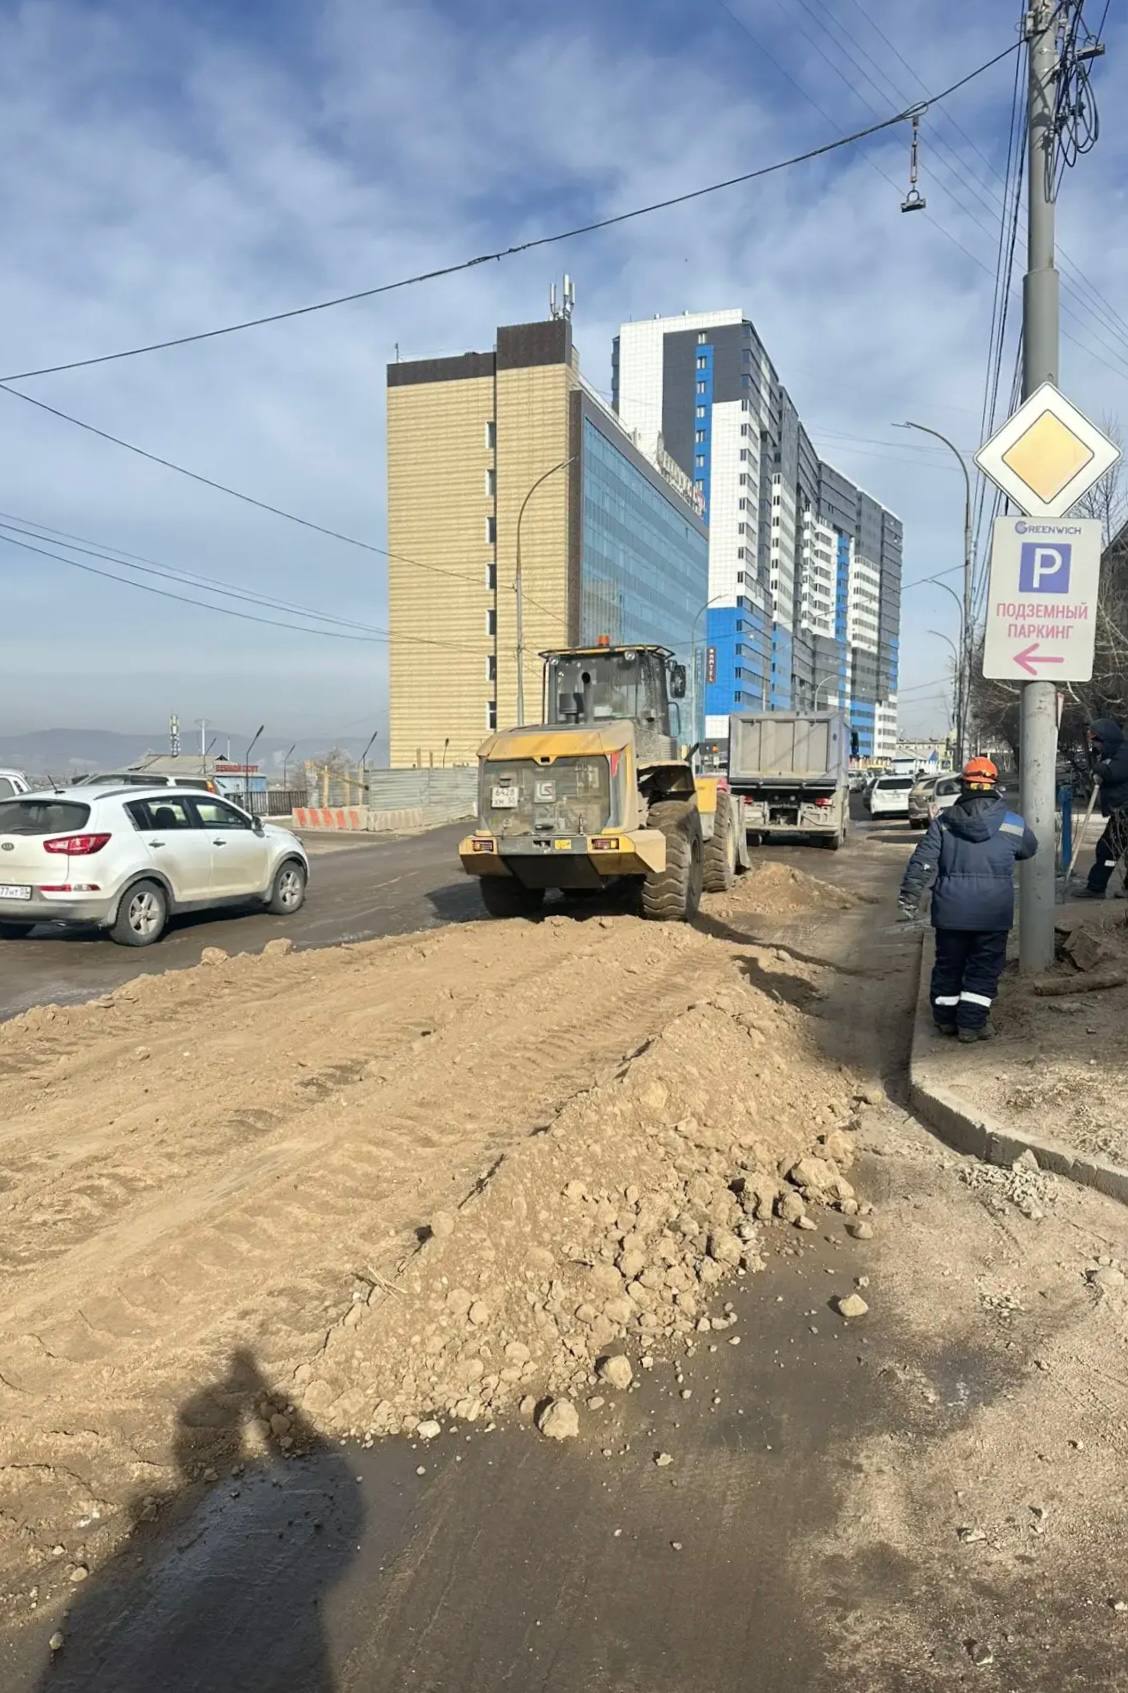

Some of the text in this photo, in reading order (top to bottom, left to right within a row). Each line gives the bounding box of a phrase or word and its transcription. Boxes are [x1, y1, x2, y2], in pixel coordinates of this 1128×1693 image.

[1015, 521, 1081, 535] GREENWICH
[1032, 547, 1063, 588] P
[996, 601, 1088, 620] ПОДЗЕМНЫЙ
[1008, 623, 1074, 639] ПАРКИНГ
